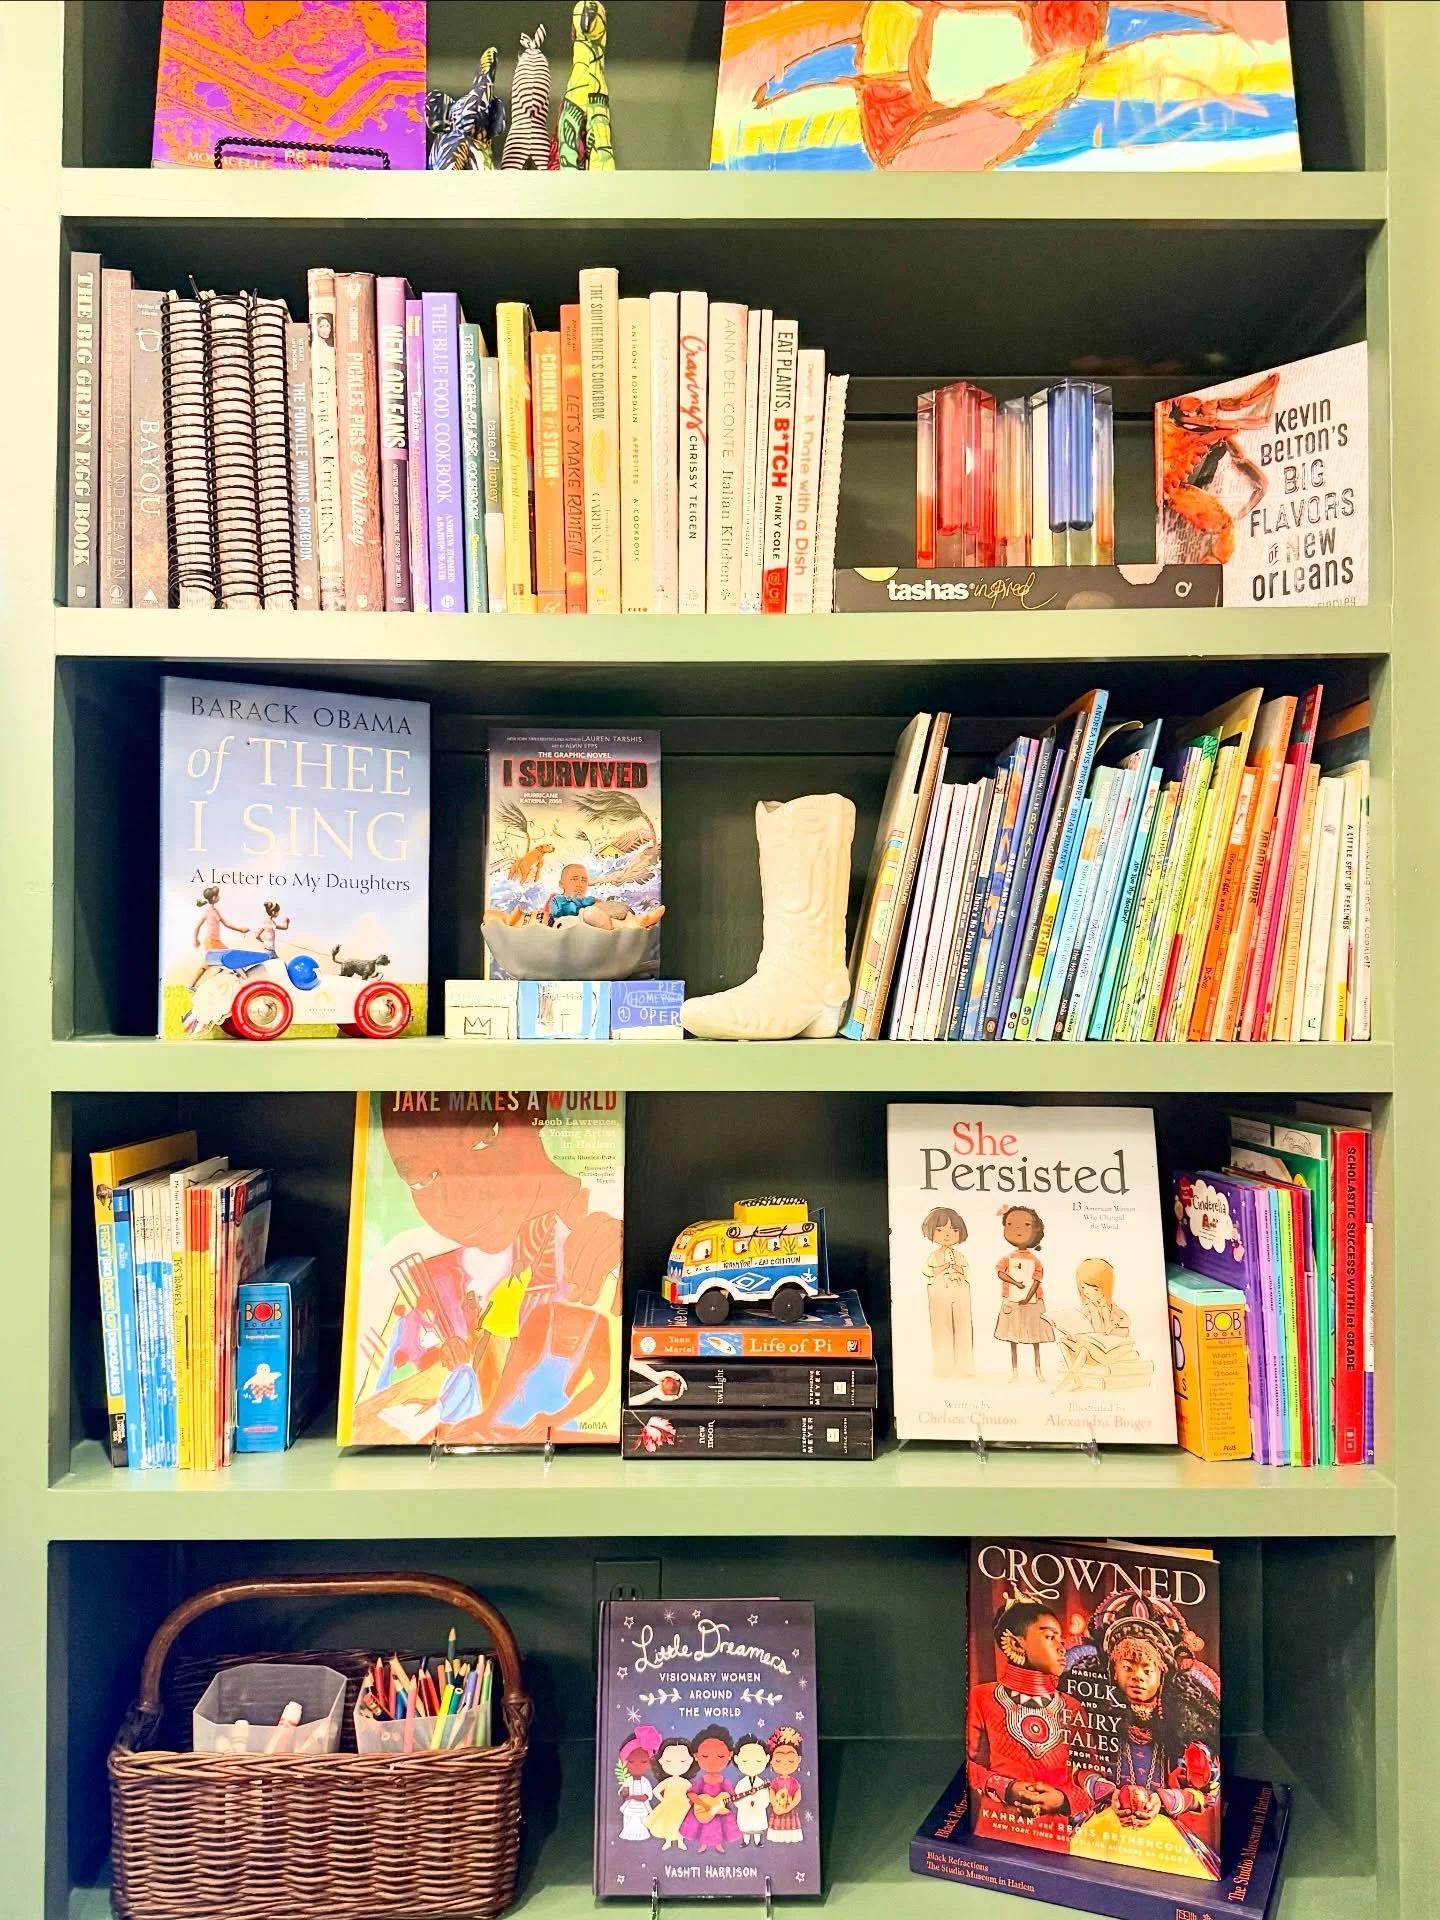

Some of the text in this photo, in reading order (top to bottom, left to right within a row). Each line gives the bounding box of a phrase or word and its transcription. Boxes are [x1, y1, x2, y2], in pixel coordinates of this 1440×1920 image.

[591, 284, 605, 420] THE SOUTHERNER'S COOKBOOK
[777, 332, 793, 355] EAT
[293, 383, 306, 403] THE
[383, 325, 405, 448] NEW ORLEANS
[431, 304, 453, 504] THE BLUE FOOD COOKBOOK
[681, 336, 707, 444] Cravings
[774, 359, 792, 412] PLANTS,
[74, 272, 93, 566] THE BIG GREEN EGG BOOK
[113, 279, 125, 580] BETWEEN HARLEM AND HEAVEN
[294, 406, 308, 456] FONVILLE
[1275, 399, 1331, 434] Kevin
[140, 420, 160, 516] BAYOU
[486, 420, 499, 503] taste of honey
[566, 394, 582, 556] LET'S MAKE RAMEN!
[1283, 459, 1324, 494] BIG
[296, 460, 311, 504] WINANS
[689, 436, 698, 539] CHRISSY TEIGEN
[720, 470, 734, 583] Italian Kitchen
[772, 495, 783, 560] PINKY COLE
[1250, 488, 1355, 537] FLAVORS
[298, 506, 313, 561] COOKBOOK
[1268, 544, 1279, 565] OF
[887, 572, 1057, 609] tashas inspired
[191, 696, 412, 735] BARACK OBAMA
[187, 736, 410, 796] of THEE
[503, 760, 648, 788] I SURVIVED
[1035, 751, 1051, 788] TOMORROW
[1032, 802, 1039, 810] BE
[1056, 704, 1104, 871] ANDREA DAVIS PINKNEY BRIAN PINKNEY
[187, 801, 409, 862] I SING
[1345, 832, 1354, 857] LITTLE
[191, 869, 410, 894] A Letter to My Daughters
[1247, 829, 1269, 904] JABARI JUMPS
[1344, 861, 1352, 879] SPOT
[1214, 852, 1236, 931] Green Eggs and Ham
[1343, 883, 1351, 892] OF
[1341, 895, 1351, 929] FEELINGS
[956, 892, 983, 991] There's No Place Like Space!
[1035, 913, 1053, 957] SIT-IN
[392, 1091, 617, 1112] JAKE MAKES A WORLD
[953, 1121, 1019, 1156] She
[920, 1148, 1130, 1195] Persisted
[1344, 1147, 1358, 1218] SCHOLASTIC
[1193, 1194, 1226, 1213] Cinderella
[1344, 1222, 1357, 1274] SUCCESS
[98, 1224, 121, 1395] FIRST BIG BOOK OF DINOSAURS
[245, 1303, 281, 1321] BOB
[1344, 1278, 1356, 1309] WITH
[1205, 1311, 1241, 1331] BOB
[664, 1346, 695, 1354] Martel
[750, 1337, 832, 1352] Life of Pi
[1344, 1331, 1355, 1371] GRADE
[716, 1369, 727, 1405] twilight
[977, 1545, 1206, 1606] CROWNED
[632, 1619, 791, 1675] Little Dreamers
[659, 1673, 761, 1682] VISIONARY WOMEN
[1072, 1669, 1107, 1680] MAGICAL
[679, 1708, 741, 1717] THE WORLD
[689, 1690, 732, 1699] AROUND
[1067, 1680, 1126, 1709] FOLK
[1062, 1709, 1122, 1733] FAIRY
[1060, 1729, 1119, 1753] TALES
[1069, 1751, 1110, 1762] FROM THE
[1066, 1760, 1113, 1774] DIASPORA
[665, 1865, 758, 1878] VASHTI HARRISON
[927, 1852, 989, 1871] Black Refractions
[927, 1861, 1035, 1892] The Studio Museum in Harlem
